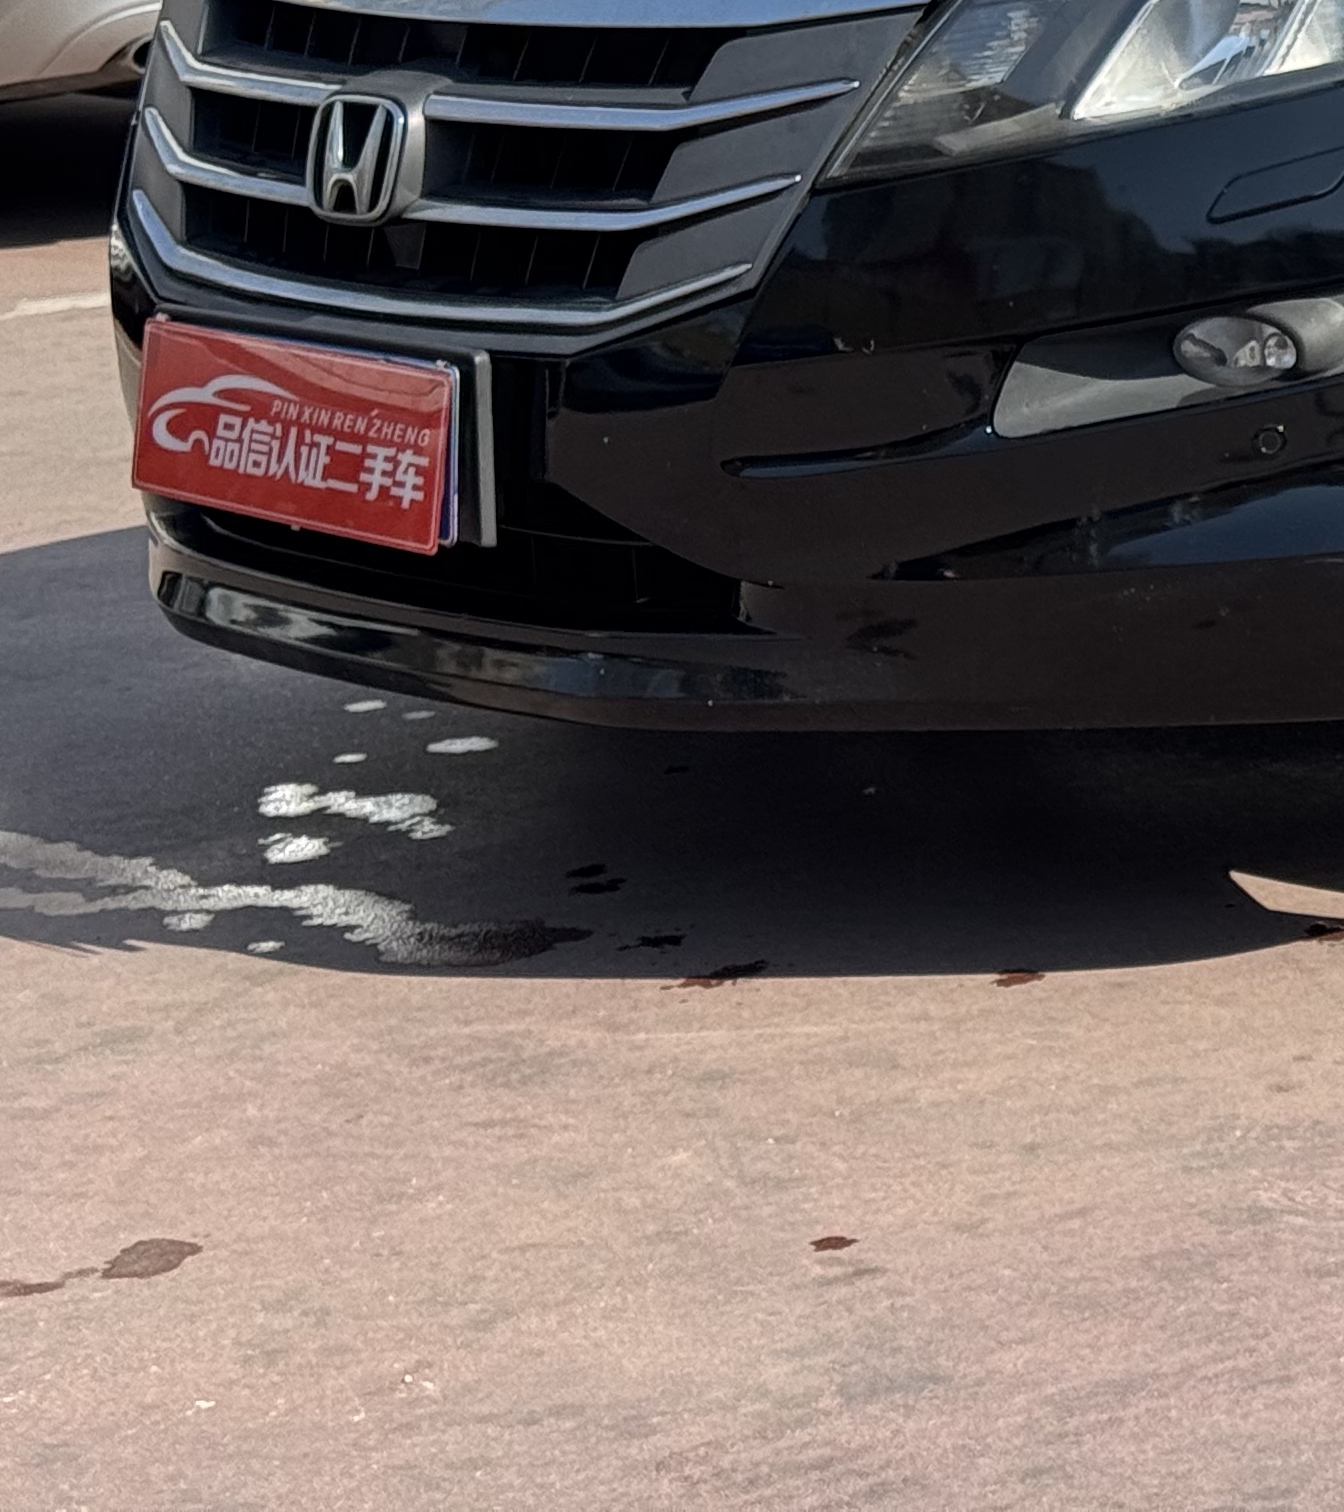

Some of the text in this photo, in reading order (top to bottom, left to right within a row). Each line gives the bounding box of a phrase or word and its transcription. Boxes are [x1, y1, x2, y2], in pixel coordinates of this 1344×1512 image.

[208, 413, 430, 510] 品信认证二手车
